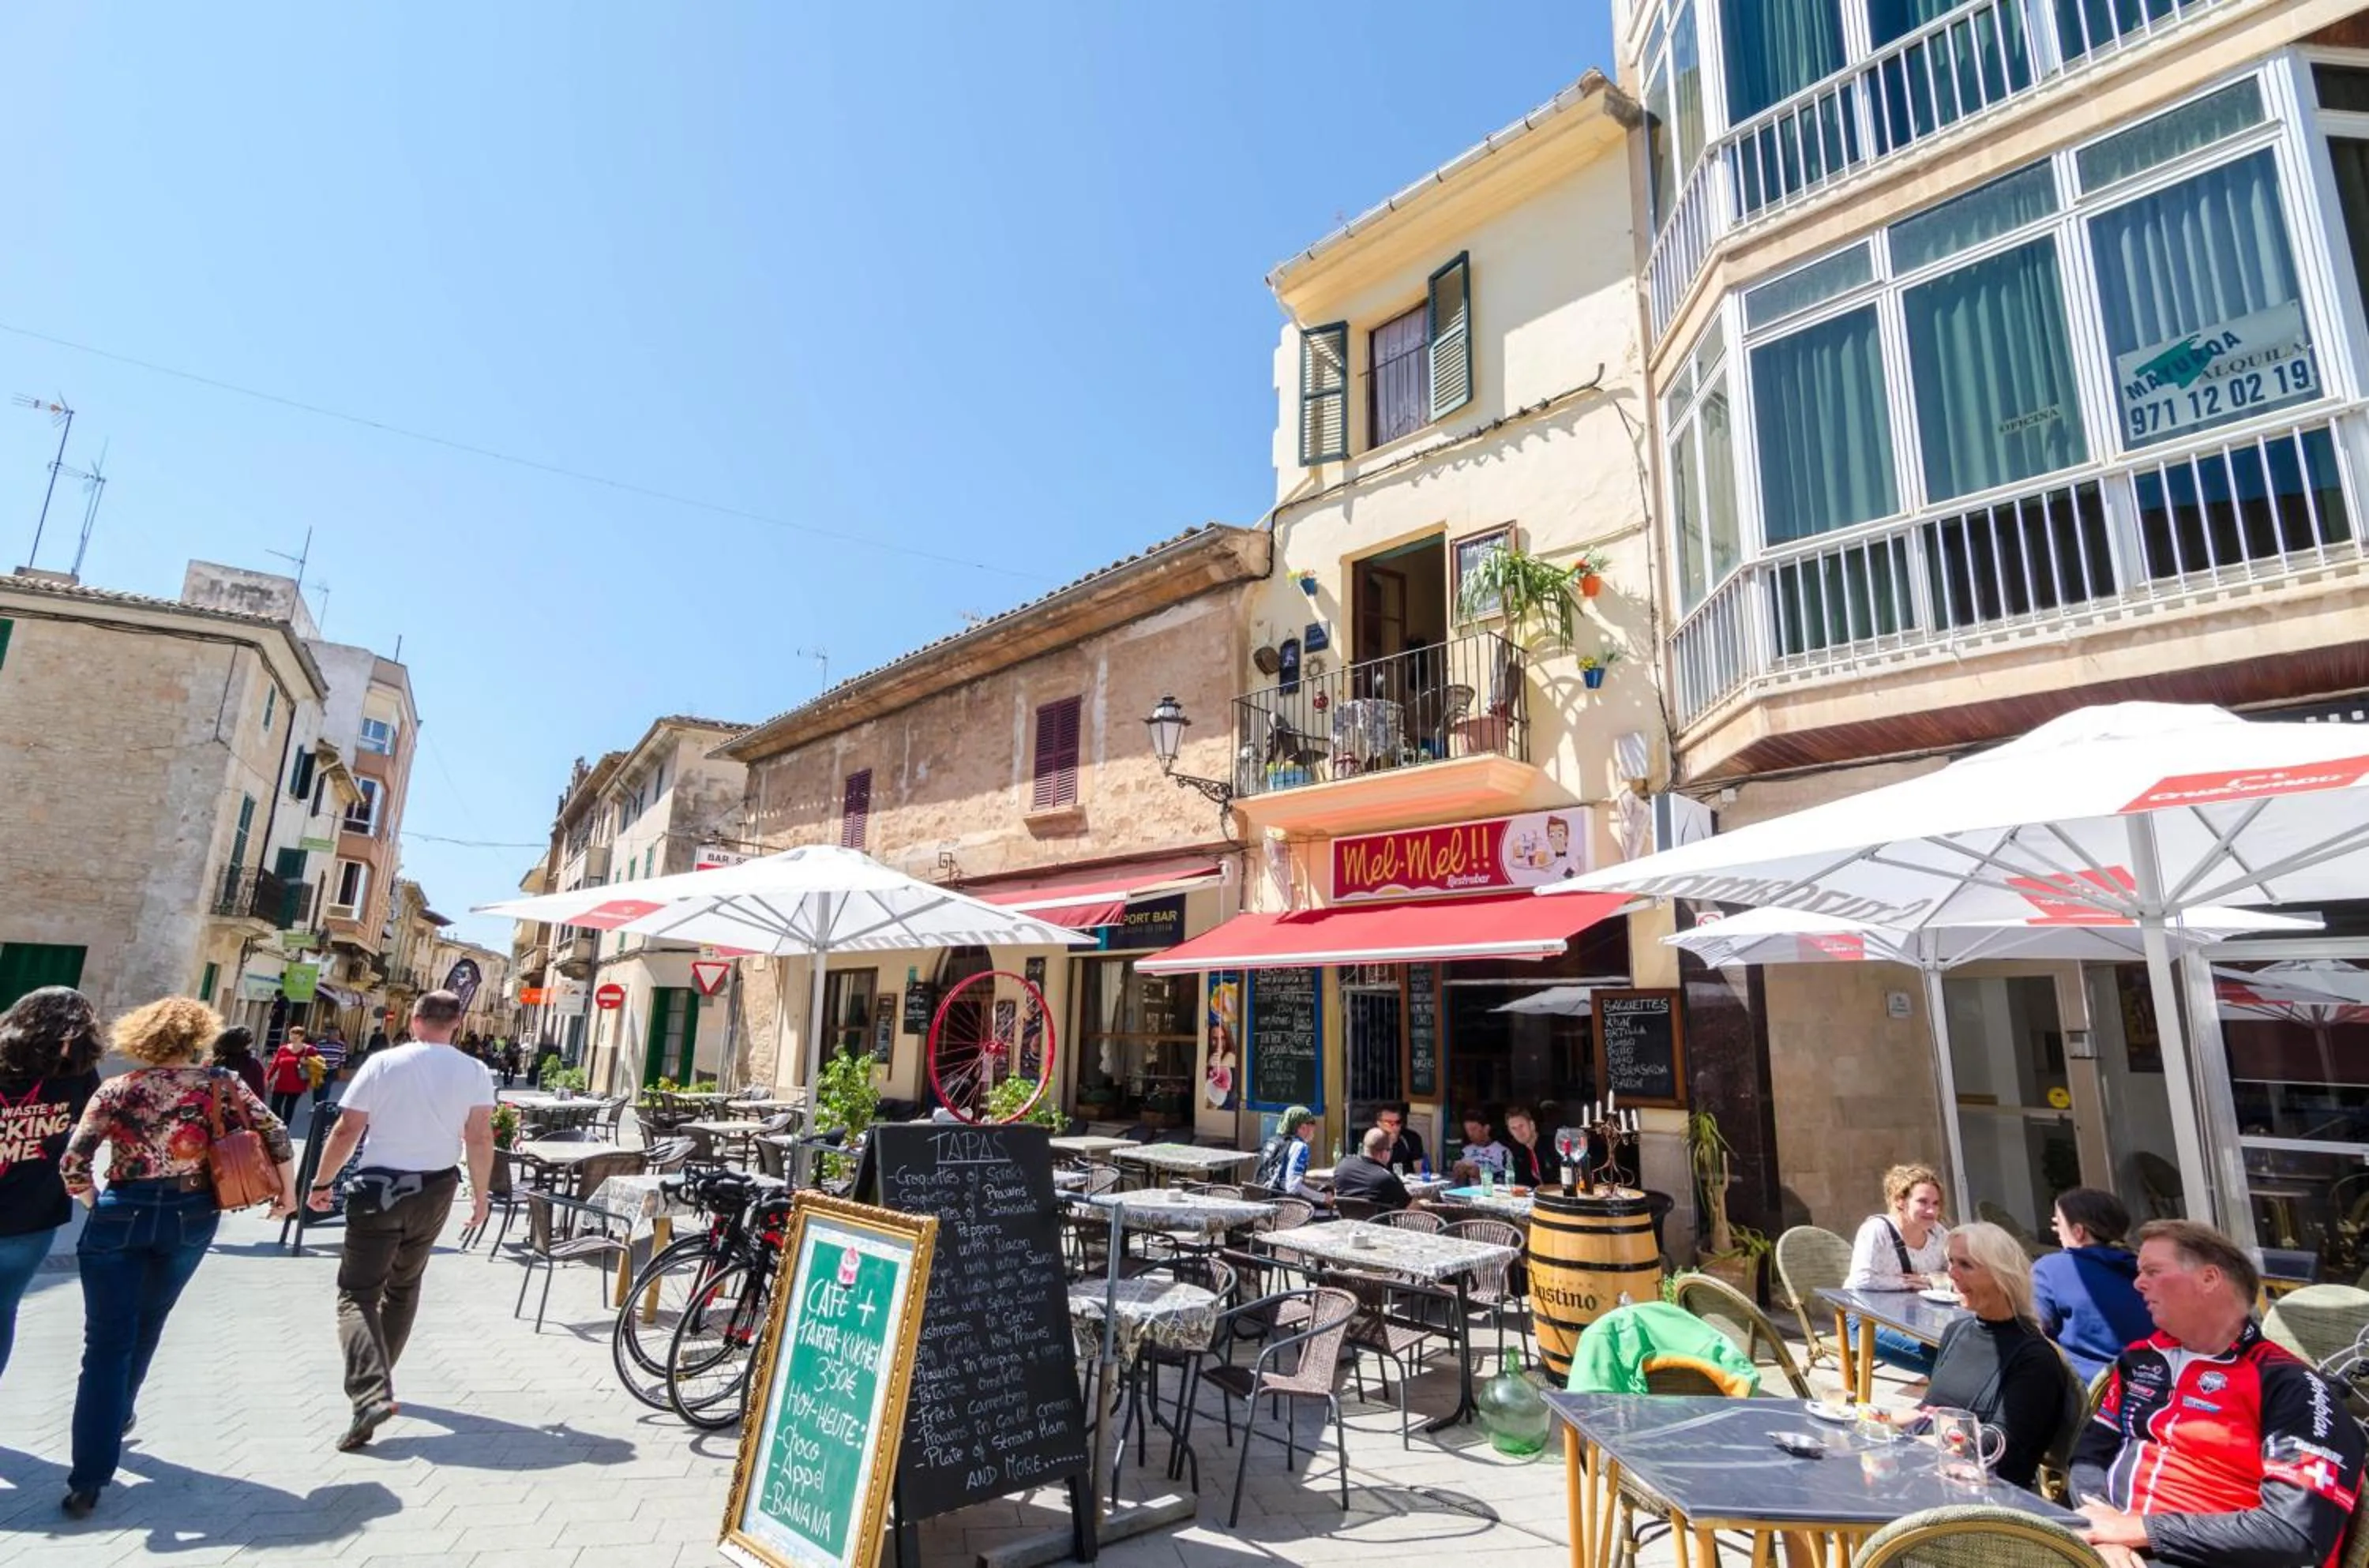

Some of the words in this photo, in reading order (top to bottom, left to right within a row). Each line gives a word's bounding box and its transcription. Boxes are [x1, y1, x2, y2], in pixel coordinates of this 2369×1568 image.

[2125, 331, 2242, 400] MAYURQA
[2131, 398, 2177, 435] 971
[2187, 390, 2222, 419] 12
[2228, 373, 2266, 407] 02
[2273, 359, 2311, 395] 19
[708, 853, 729, 863] BAR
[1124, 913, 1151, 925] PORT
[1152, 910, 1178, 923] BAR
[2, 1104, 48, 1118] WASTE
[927, 1131, 1012, 1163] TAPAS
[954, 1221, 1002, 1243] Peppers
[922, 1319, 974, 1341] ushrooms
[1038, 1421, 1069, 1440] Ham
[966, 1465, 998, 1491] AND
